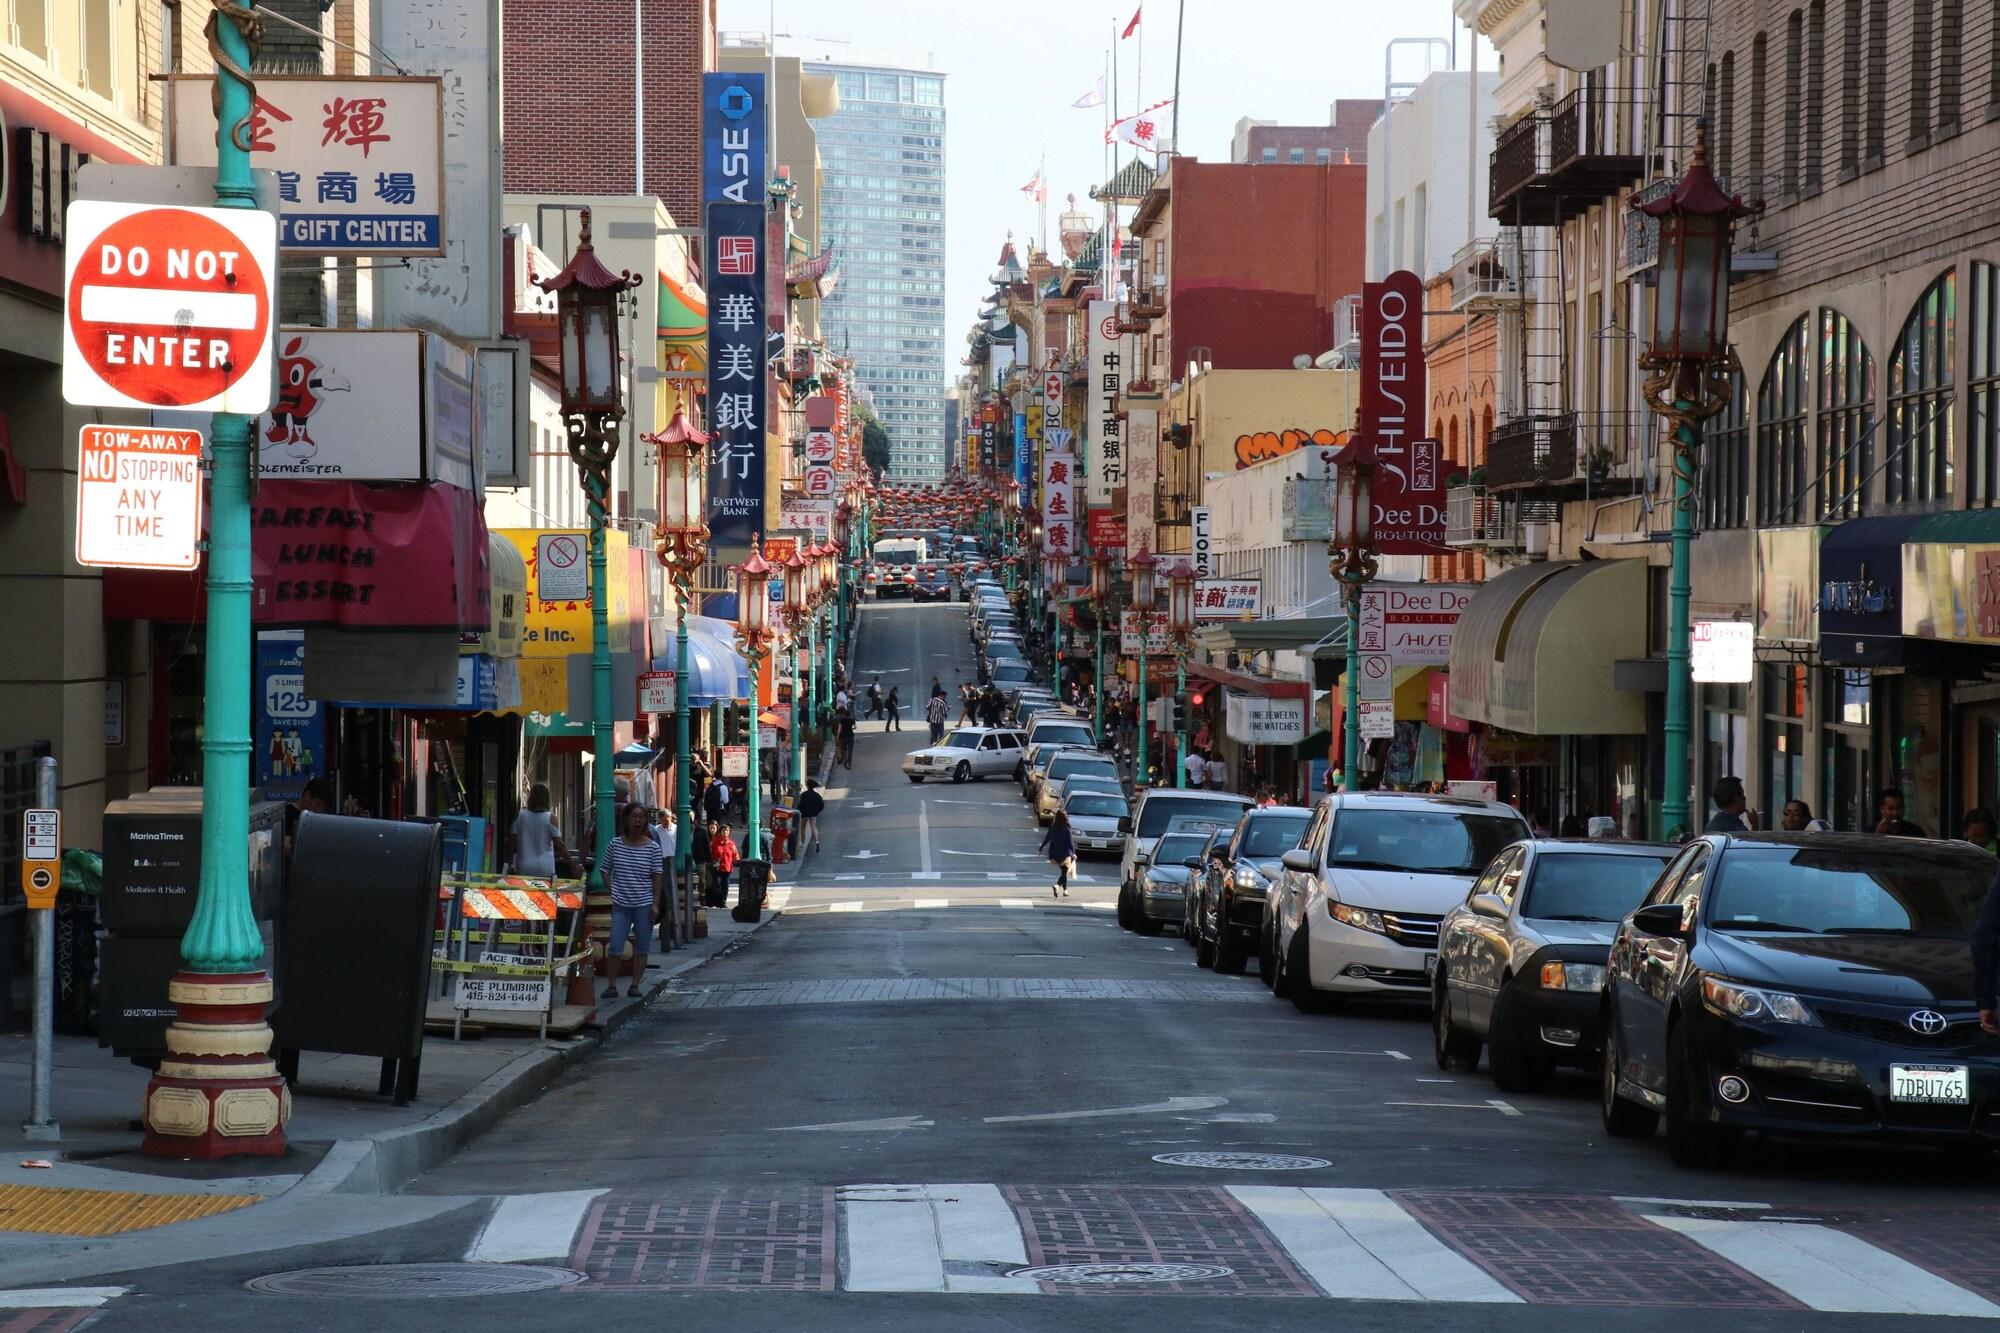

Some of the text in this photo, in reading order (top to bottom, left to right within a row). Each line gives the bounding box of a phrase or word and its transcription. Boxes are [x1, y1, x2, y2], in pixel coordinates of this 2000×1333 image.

[723, 127, 749, 202] ASE
[294, 220, 340, 241] GIFT
[345, 220, 427, 242] CENTER
[101, 244, 239, 281] DO NOT
[107, 334, 230, 370] ENTER
[715, 294, 758, 480] 華美銀行
[1375, 291, 1407, 494] SHISEIDO
[1102, 352, 1120, 483] 中国工商银行
[92, 432, 191, 450] TOW-AWAY
[84, 450, 193, 483] NO STOPPING
[250, 459, 342, 474] DLEMEISTER
[1415, 446, 1432, 488] 美之屋
[117, 488, 162, 510] ANY
[1047, 461, 1069, 547] 廣生隆
[251, 507, 376, 531] AKFAST
[723, 507, 749, 515] BANK
[1418, 505, 1447, 526] De
[115, 515, 164, 537] TIME
[1374, 530, 1446, 542] BOUTIQU
[278, 543, 376, 568] LUNCH
[275, 580, 376, 604] ESSERT
[1391, 592, 1469, 610] Dee De
[1361, 594, 1382, 649] 美之屋
[1390, 615, 1456, 626] BOUTIQ
[544, 627, 575, 642] Inc.
[1391, 633, 1452, 648] SHISEI
[1694, 624, 1711, 640] NO
[640, 679, 650, 689] NO
[269, 692, 310, 713] 125
[649, 697, 667, 705] TIME
[1360, 703, 1370, 714] NO
[1265, 711, 1298, 719] JEWELRY
[1264, 722, 1300, 731] WATCHES
[130, 832, 184, 840] MarinaTimes
[432, 961, 454, 970] AUTION
[486, 954, 546, 967] ACE PLUMB
[462, 981, 545, 992] ACE PLUMBING
[466, 991, 538, 1001] 415-824-6444
[1897, 1079, 1963, 1098] 7DBU765
[1896, 1096, 1964, 1105] MELODY TOYOTA
